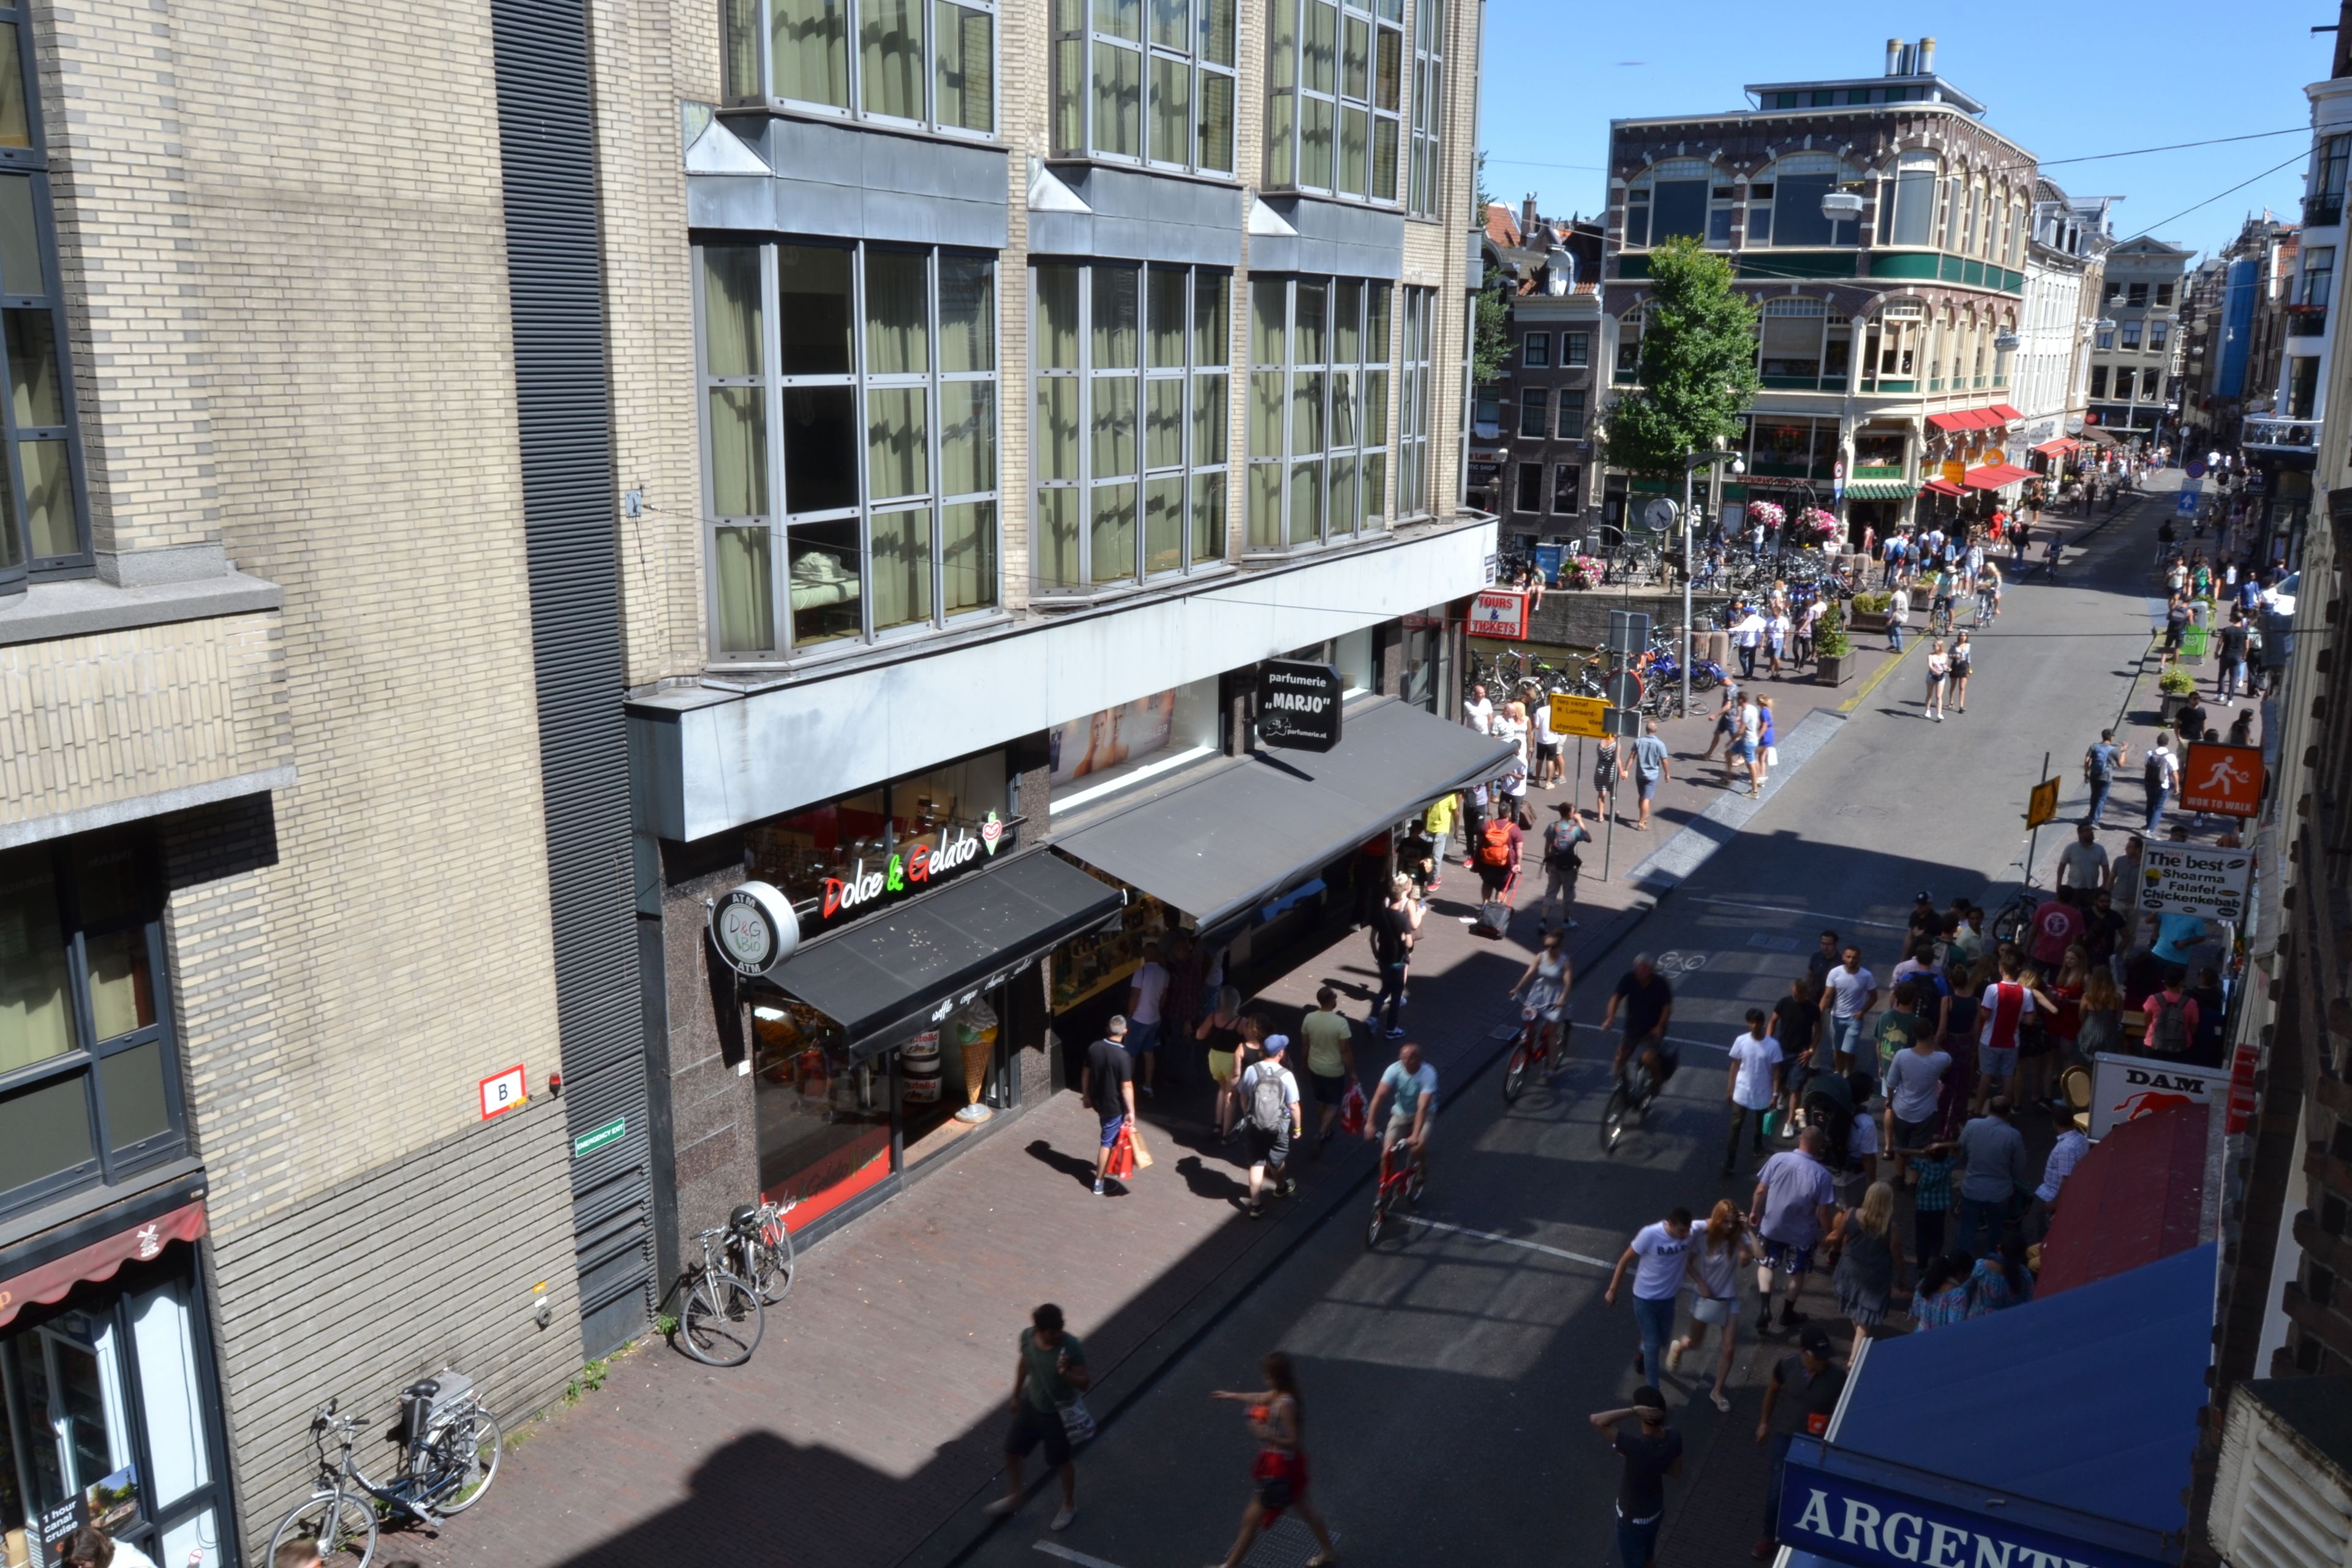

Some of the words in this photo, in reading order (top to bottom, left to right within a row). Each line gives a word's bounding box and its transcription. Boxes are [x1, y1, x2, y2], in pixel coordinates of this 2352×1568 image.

[1479, 596, 1513, 609] TOURS
[1491, 609, 1499, 620] &
[1473, 620, 1516, 634] TICKETS
[1269, 673, 1327, 687] parfumerie
[1287, 729, 1327, 739] parfumerie.nl
[2187, 797, 2209, 807] WOK
[2211, 799, 2223, 809] TO
[2225, 801, 2252, 812] WALK
[2148, 851, 2181, 867] The
[2186, 856, 2225, 872] best
[824, 858, 883, 918] Dolce
[887, 854, 903, 891] &
[908, 827, 978, 882] Gelato
[2163, 869, 2225, 884] Shoarma
[2169, 881, 2216, 895] Falafel
[732, 893, 756, 908] ATM
[2143, 889, 2241, 908] Chickenkebab
[737, 961, 761, 974] ATM
[932, 998, 953, 1022] waffle
[2126, 1069, 2204, 1095] DAM
[498, 1084, 508, 1101] B
[577, 1129, 611, 1150] EMERGENCY
[611, 1123, 624, 1134] EXIT
[42, 1514, 49, 1523] 1
[51, 1501, 77, 1519] hour
[44, 1512, 73, 1533] canal
[45, 1520, 78, 1543] cruise
